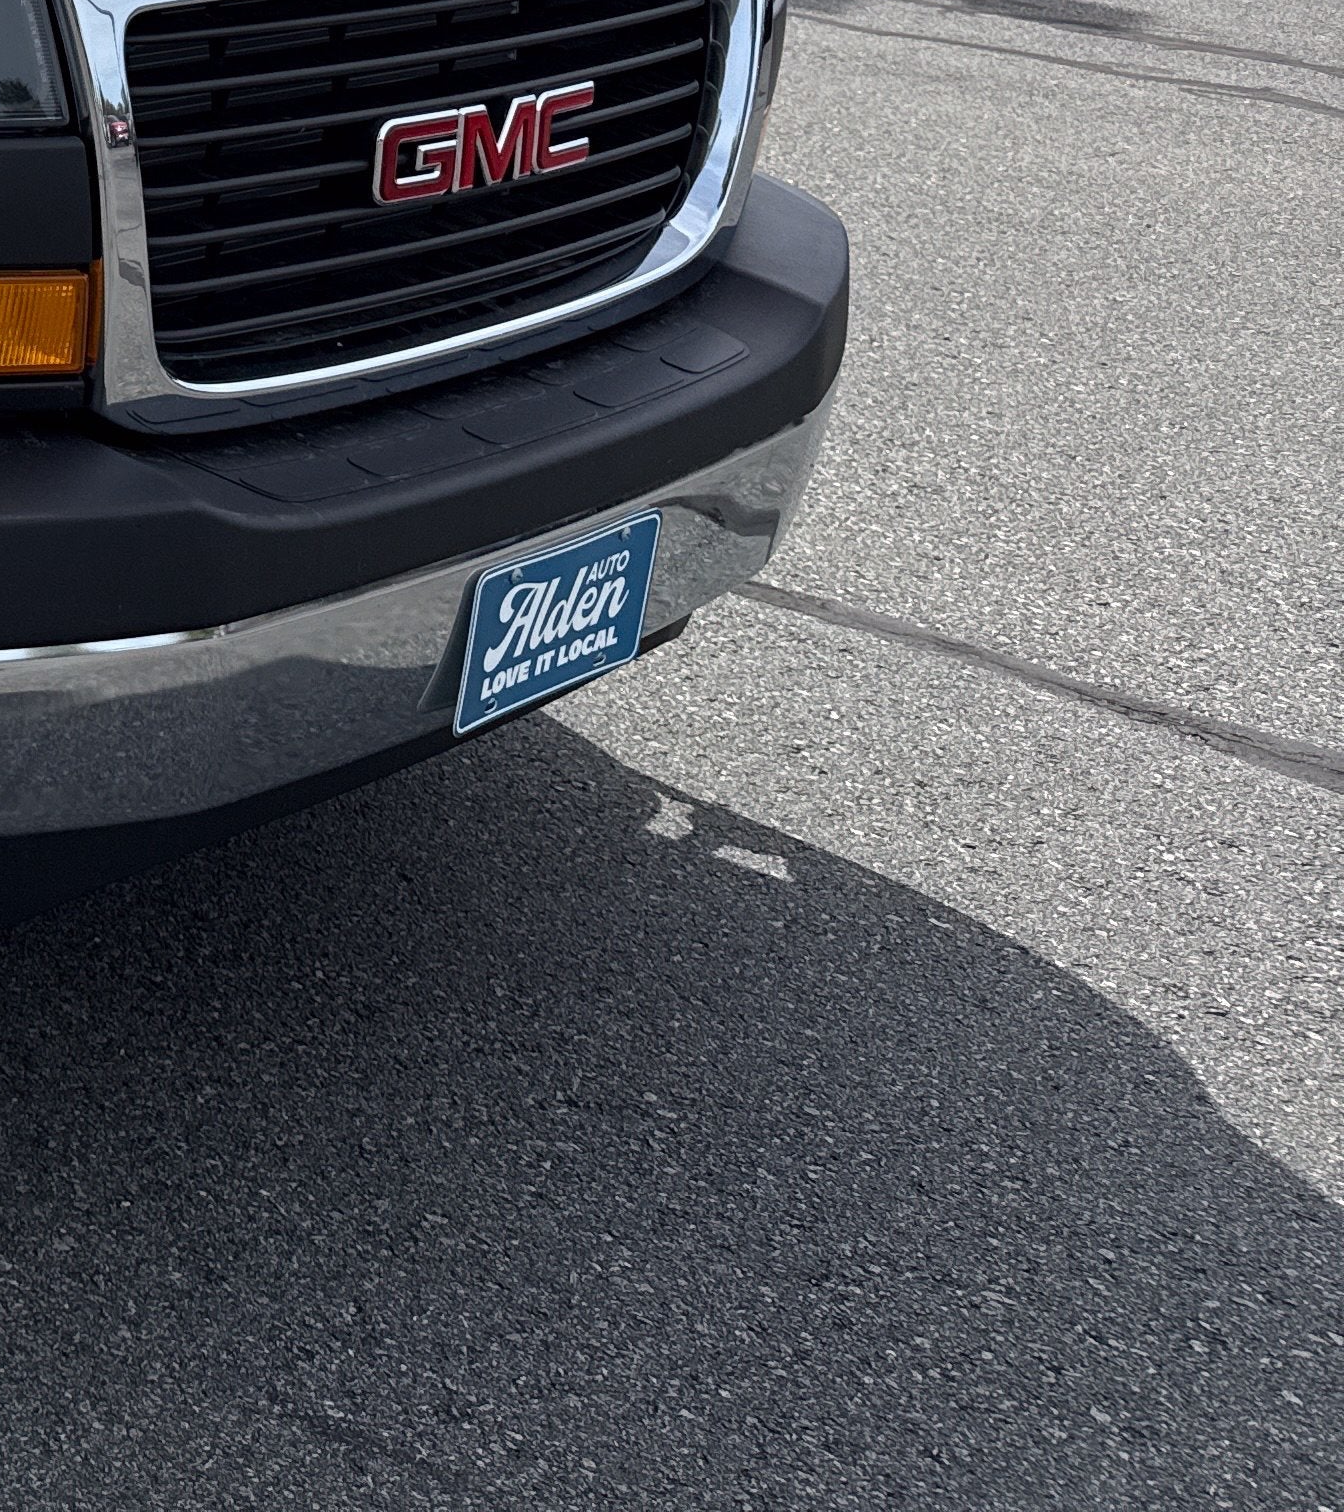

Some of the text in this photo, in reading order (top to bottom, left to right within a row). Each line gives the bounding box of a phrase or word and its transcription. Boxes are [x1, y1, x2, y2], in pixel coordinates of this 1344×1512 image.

[373, 80, 594, 206] GMC
[586, 549, 631, 585] AUTO
[480, 625, 619, 701] LOVE IT LOCAL
[483, 565, 631, 673] Alden
